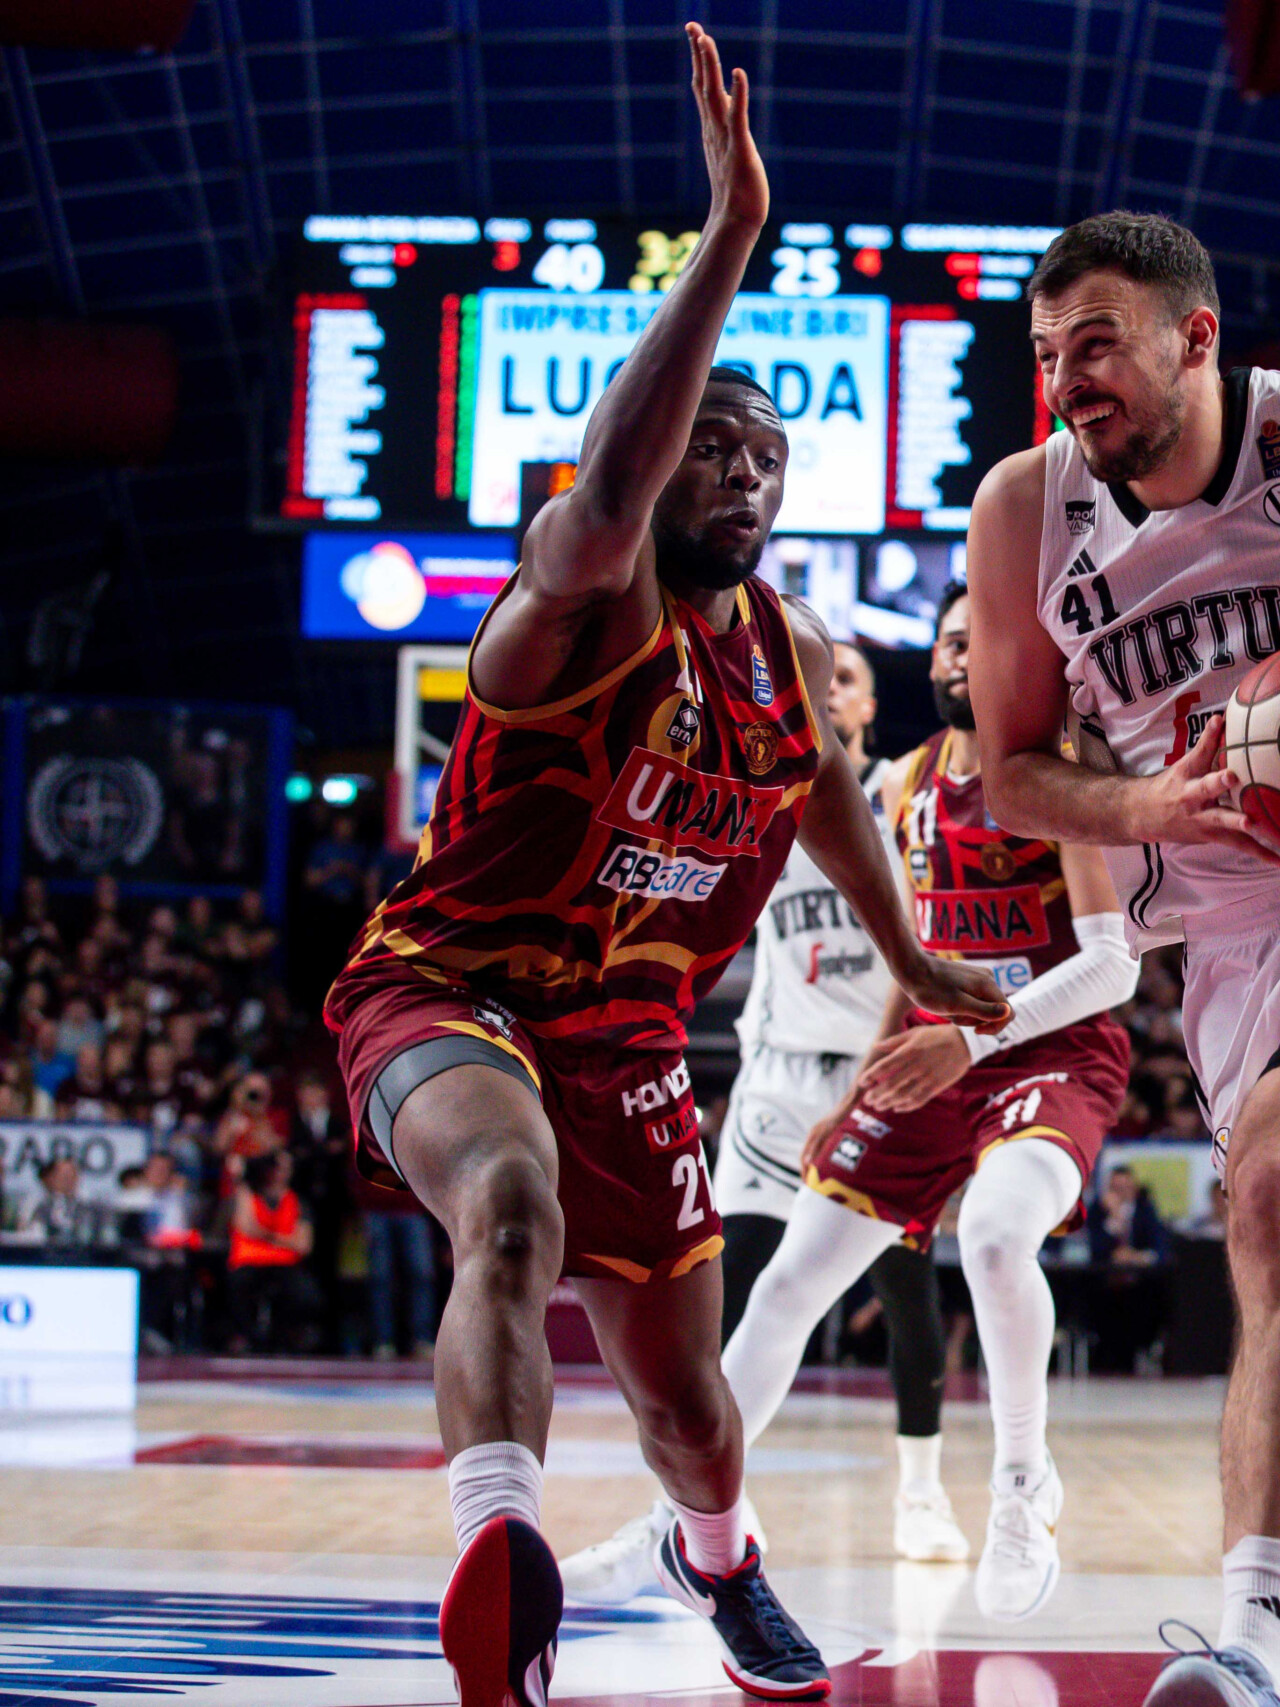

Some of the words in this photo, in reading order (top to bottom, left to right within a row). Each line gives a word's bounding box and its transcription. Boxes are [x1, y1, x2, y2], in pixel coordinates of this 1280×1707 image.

[532, 243, 605, 294] 40
[770, 247, 841, 298] 25
[1060, 573, 1121, 635] 41
[626, 763, 759, 847] UMANA
[601, 847, 721, 897] RBcare
[916, 895, 1034, 942] UMANA
